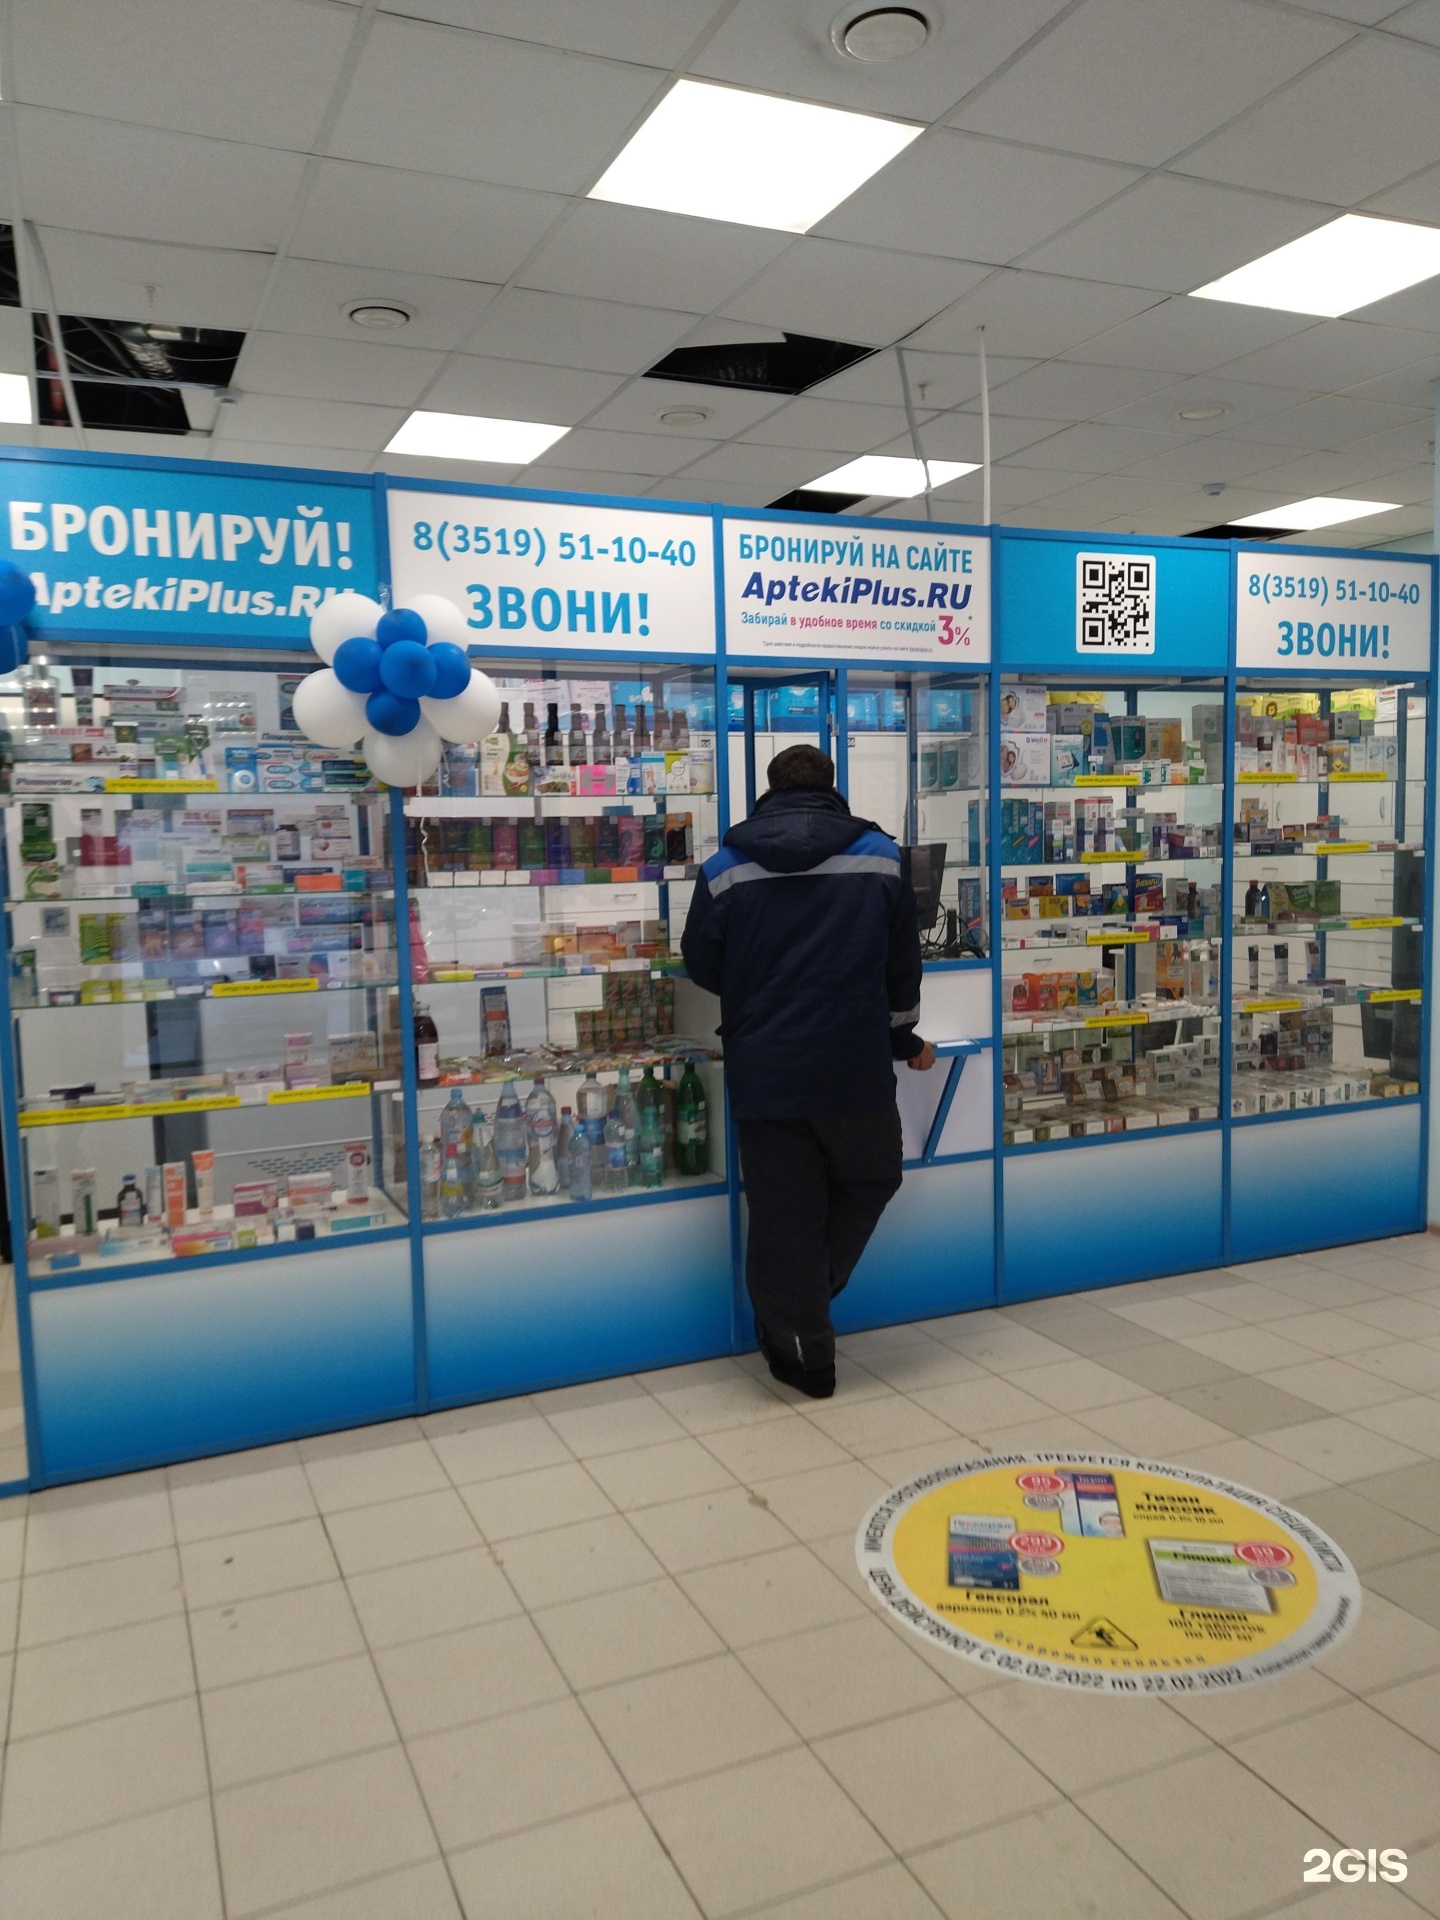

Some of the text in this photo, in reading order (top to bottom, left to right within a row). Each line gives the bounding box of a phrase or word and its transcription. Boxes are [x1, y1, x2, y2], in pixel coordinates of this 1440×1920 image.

[9, 500, 353, 570] БРОНИРУЙ!
[413, 521, 696, 567] 8(3519) 51-10-40
[739, 533, 973, 574] БРОНИРУЙ НА САЙТЕ
[741, 571, 972, 610] AptekiPlus.RU
[1249, 573, 1420, 606] 8(3519) 51-10-40
[466, 584, 650, 637] ЗВОНИ!
[741, 611, 787, 627] Забирай
[790, 617, 796, 626] в
[799, 617, 843, 629] удобное
[846, 617, 877, 631] время
[880, 621, 892, 631] со
[894, 621, 936, 633] скидкой
[1277, 621, 1389, 659] ЗВОНИ!
[1036, 1453, 1130, 1468] ТРЕБУЕТСЯ
[997, 1651, 1106, 1688] 02.02.2022
[1111, 1677, 1138, 1692] по
